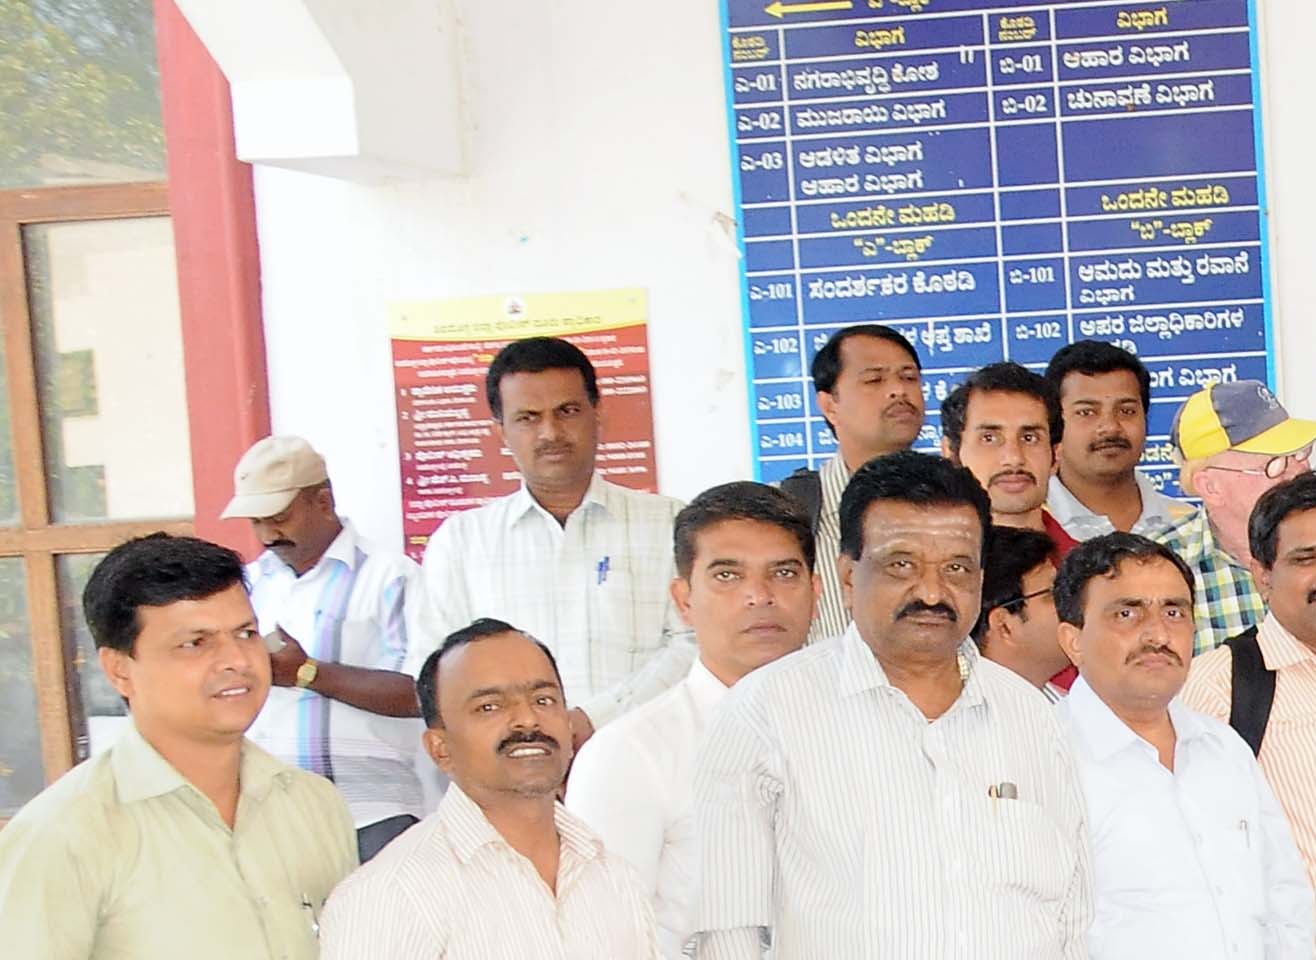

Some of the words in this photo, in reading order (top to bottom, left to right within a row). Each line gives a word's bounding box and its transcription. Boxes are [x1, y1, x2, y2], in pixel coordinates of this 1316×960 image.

[1116, 7, 1169, 30] ವಿಭಾಗ
[854, 26, 906, 49] ವಿಭಾಗ
[1063, 46, 1124, 69] ಆಹಾರ
[1128, 40, 1190, 67] ವಿಭಾಗ
[1155, 80, 1215, 107] ವಿಭಾಗ
[891, 99, 946, 121] ವಿಭಾಗ
[864, 140, 923, 166] ವಿಭಾಗ
[801, 174, 860, 196] ಆಹಾರ
[864, 169, 924, 194] ವಿಭಾಗ
[1101, 188, 1167, 212] ಒಂದನೇ
[1171, 184, 1230, 207] ಮಹಡಿ
[830, 205, 895, 229] ಒಂದನೇ
[898, 202, 956, 225] ಮಹಡಿ
[1146, 255, 1196, 285] ಮತ್ತು
[1196, 251, 1250, 275] ರವಾನೆ
[1079, 284, 1135, 306] ವಿಭಾಗ
